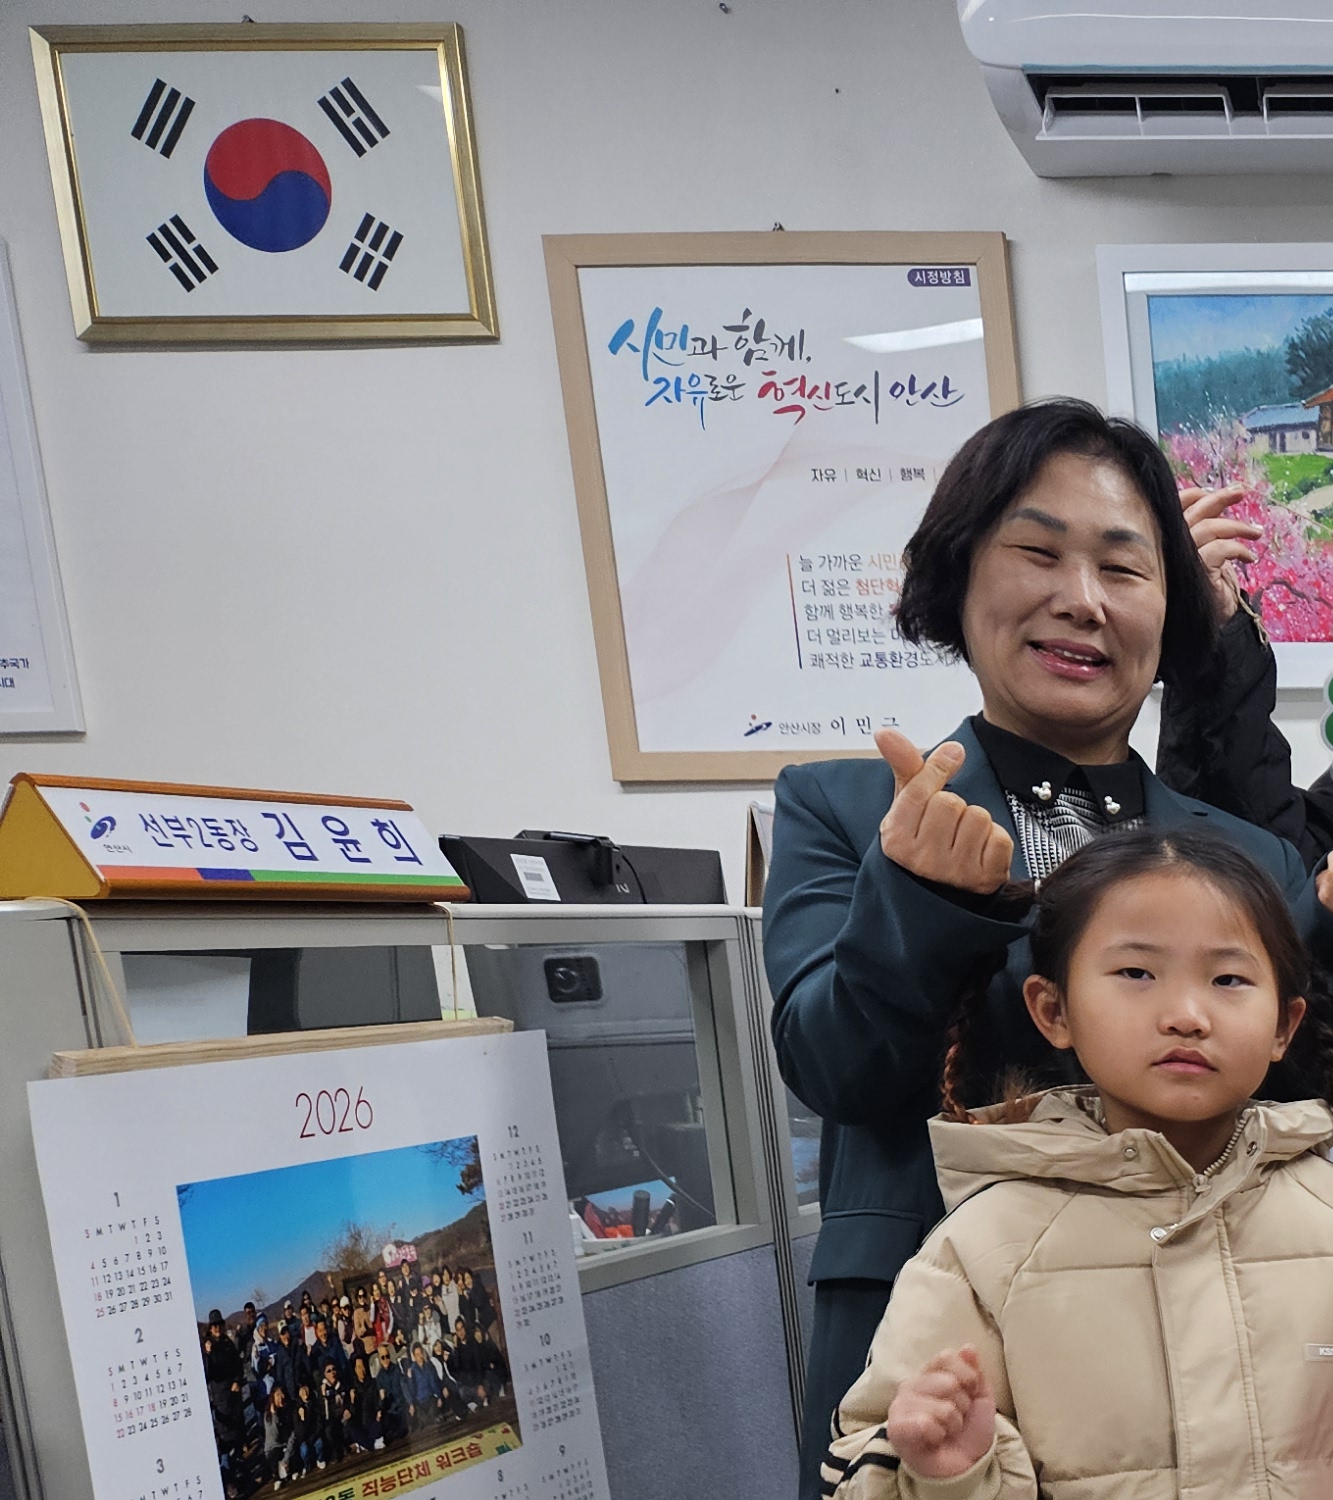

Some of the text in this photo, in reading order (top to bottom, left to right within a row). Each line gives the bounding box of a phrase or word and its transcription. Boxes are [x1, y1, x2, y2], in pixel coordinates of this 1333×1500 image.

[914, 269, 966, 285] 시정방침
[608, 307, 728, 380] 시민과
[645, 370, 966, 430] 자유로운 혁신도시 안산
[811, 467, 926, 483] 자유 혁신 행복
[799, 554, 814, 572] 늘
[819, 553, 863, 572] 가까운
[801, 579, 816, 596] 더
[821, 578, 851, 597] 젊은
[804, 603, 835, 622] 함께
[839, 602, 884, 621] 행복한
[807, 628, 822, 644] 더
[826, 627, 886, 645] 멀리보는
[810, 652, 855, 669] 쾌적한
[779, 721, 821, 735] 안산시장
[830, 716, 846, 736] 이
[856, 716, 872, 735] 민
[139, 812, 424, 866] 선부2동장 김 윤 희
[295, 1085, 374, 1139] 2026
[507, 1125, 519, 1138] 12
[113, 1192, 120, 1207] 1
[523, 1231, 534, 1245] 11
[96, 1291, 173, 1318] 25 26 27 28 29 30 31
[134, 1327, 144, 1343] 2
[539, 1333, 551, 1346] 10
[559, 1445, 566, 1457] 9
[156, 1458, 165, 1474] 3
[361, 1460, 432, 1499] 직능단체
[435, 1441, 483, 1471] 워크숍
[497, 1469, 504, 1482] 8
